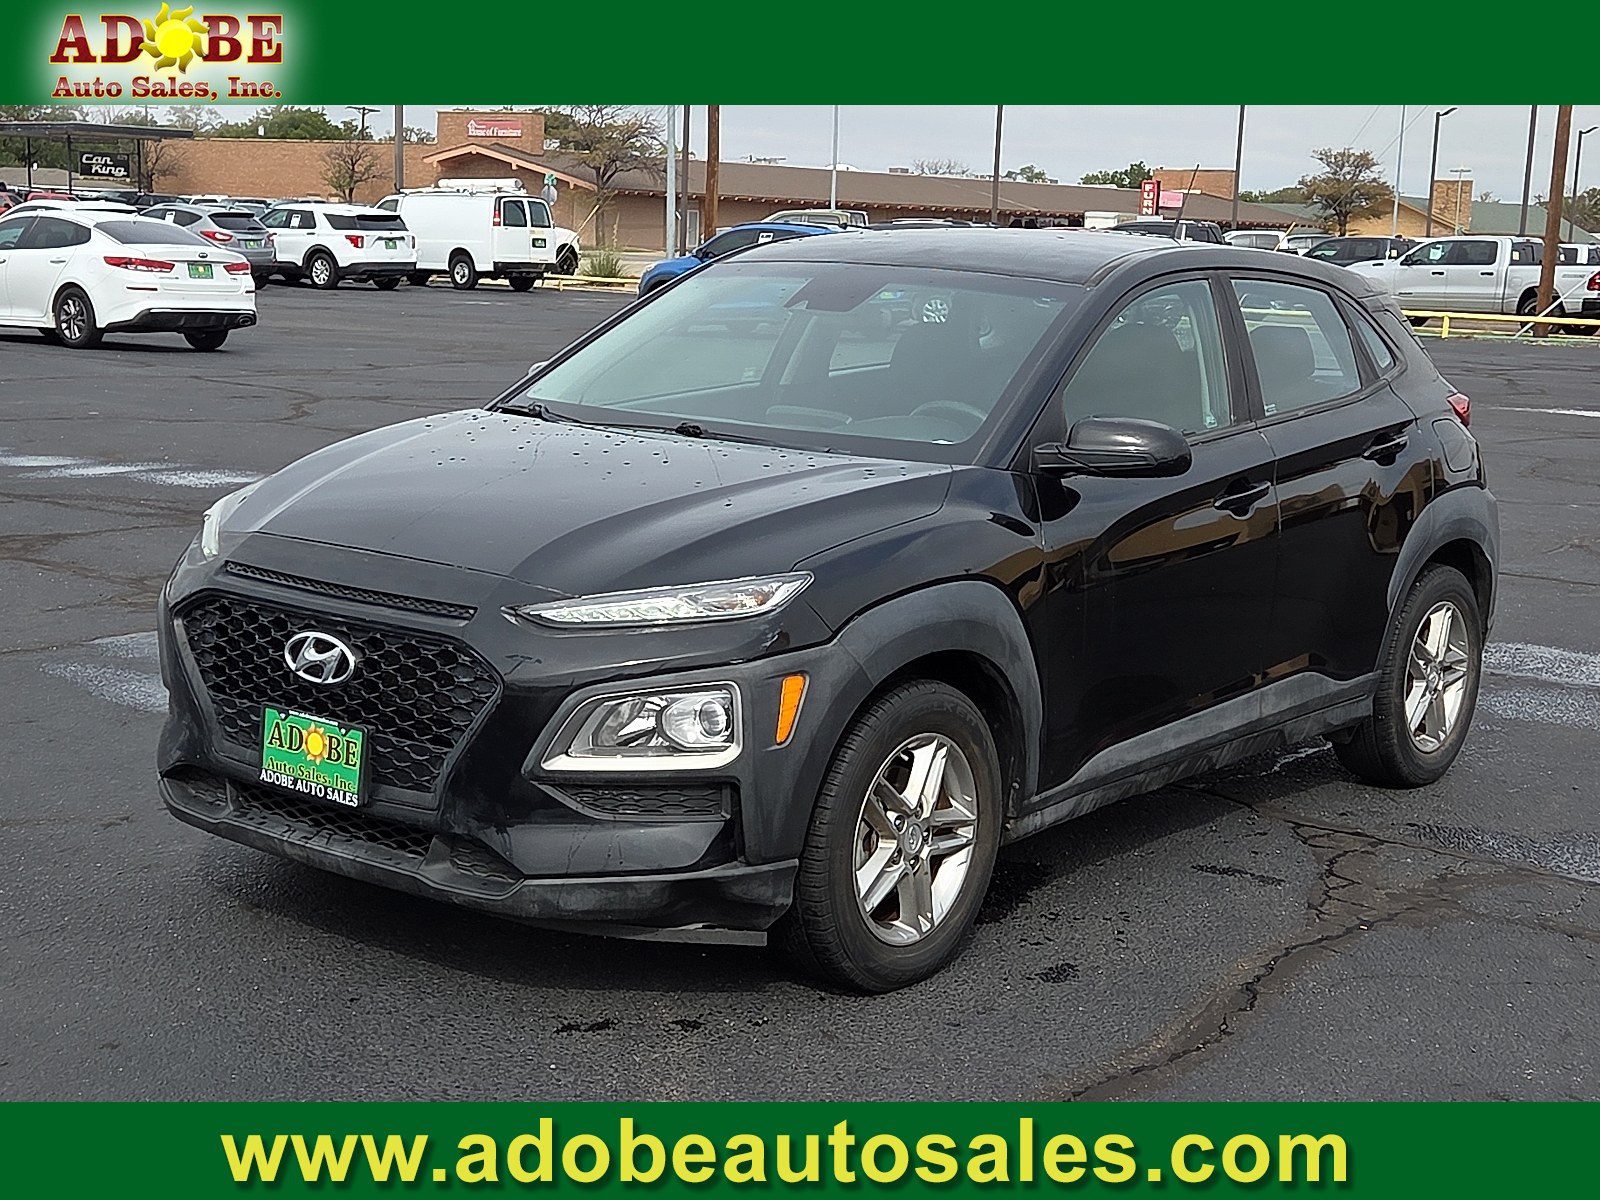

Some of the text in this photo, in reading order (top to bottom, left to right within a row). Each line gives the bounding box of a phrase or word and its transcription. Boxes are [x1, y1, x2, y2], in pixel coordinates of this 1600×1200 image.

[91, 164, 128, 177] King
[267, 720, 358, 768] ADOBE
[260, 768, 358, 808] ADOBE AUTO SALES
[267, 757, 295, 774] Auto
[335, 774, 356, 791] Inc.
